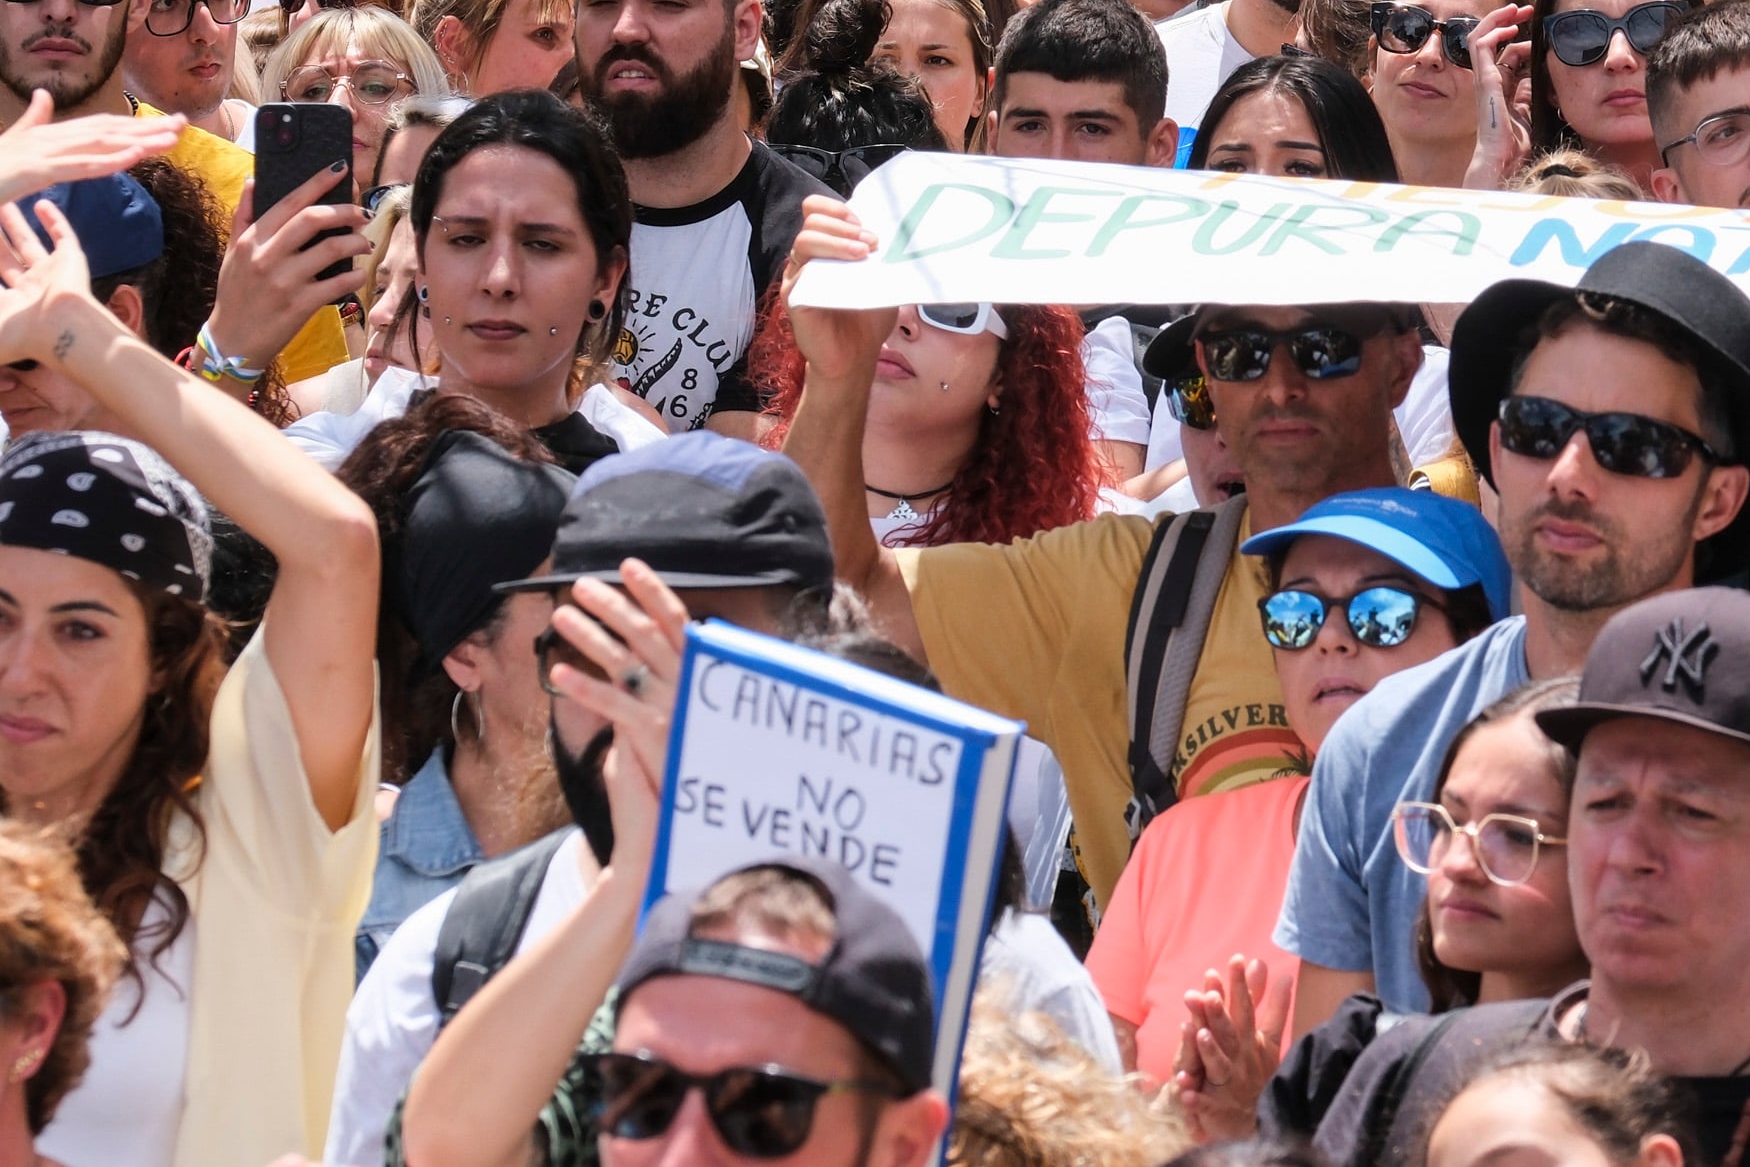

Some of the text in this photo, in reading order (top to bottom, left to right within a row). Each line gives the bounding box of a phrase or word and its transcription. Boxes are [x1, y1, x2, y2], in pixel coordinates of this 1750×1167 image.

[882, 182, 1481, 263] DEPURA
[699, 659, 953, 786] CANARIAS
[674, 778, 900, 886] SE VENDE
[797, 774, 867, 832] NO
